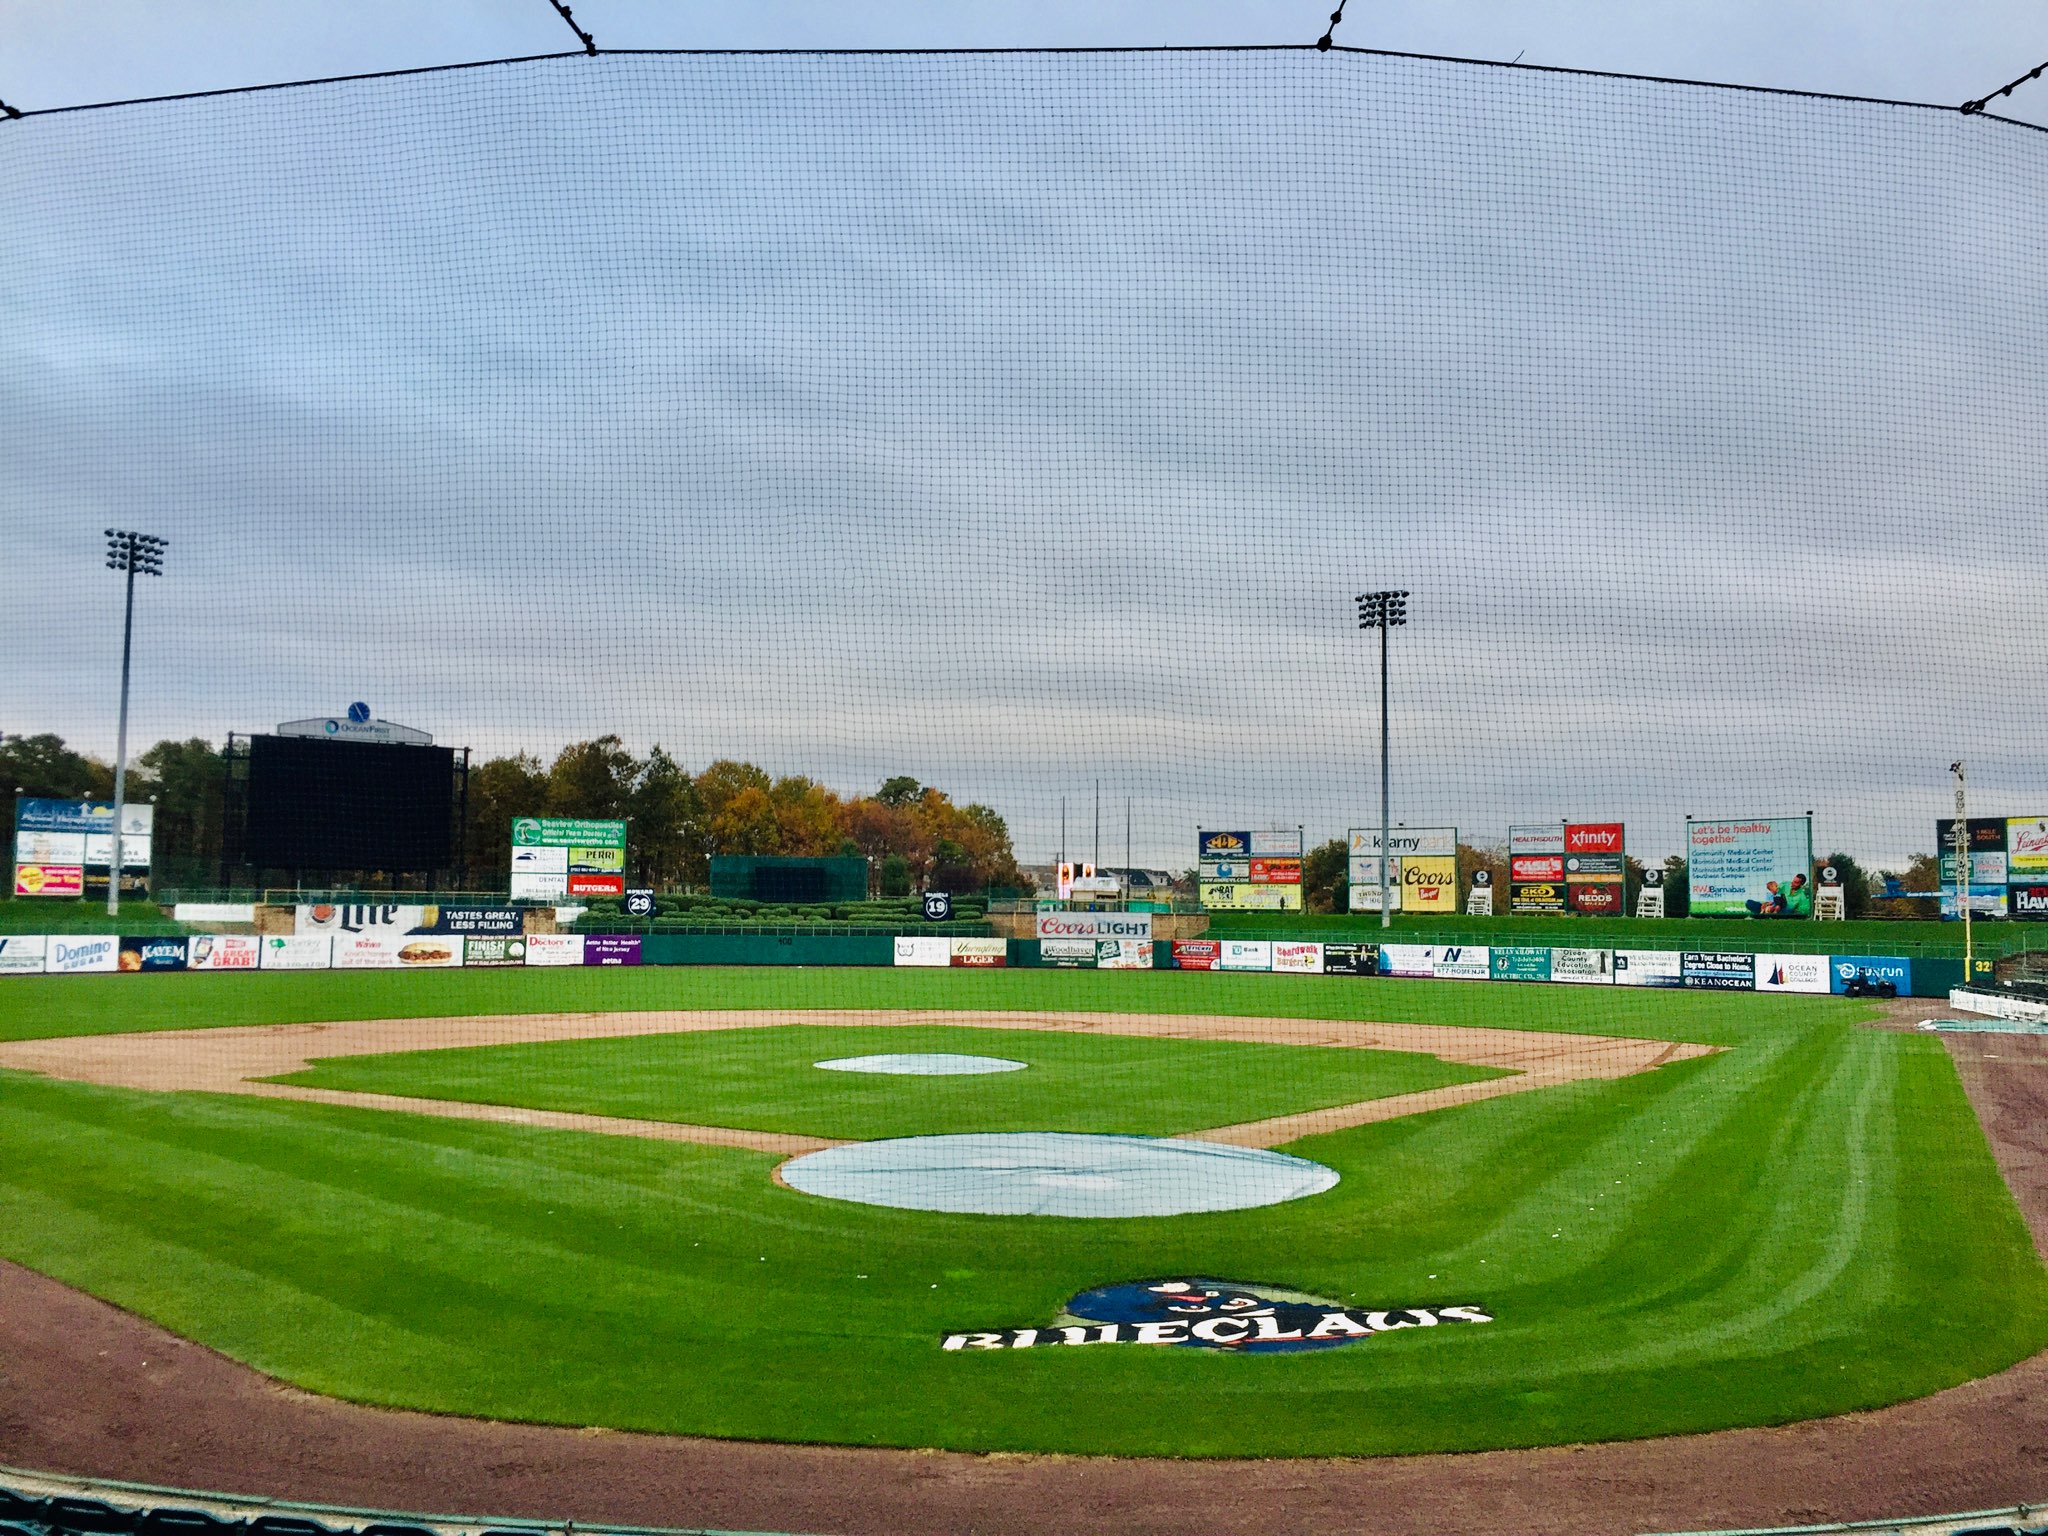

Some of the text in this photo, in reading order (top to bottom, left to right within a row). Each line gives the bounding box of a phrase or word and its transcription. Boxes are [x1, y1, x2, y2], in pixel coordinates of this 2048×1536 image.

[1691, 823, 1771, 835] Let's be healthy
[1373, 836, 1420, 851] karny
[1571, 831, 1617, 847] xfinity
[1404, 866, 1454, 885] Coors
[631, 898, 650, 910] 29
[929, 901, 946, 912] 19
[446, 911, 519, 921] TASTES GREAT,
[451, 921, 514, 930] LESS FILLING
[1040, 917, 1149, 936] Coors LIGHT
[467, 940, 506, 951] FINISH
[529, 936, 564, 946] Doctors
[55, 941, 111, 963] Domino
[142, 945, 185, 961] KAYEM
[213, 957, 256, 967] GRAB!
[963, 955, 995, 964] LAGER
[1700, 953, 1715, 962] Your
[1716, 954, 1752, 963] Bachelor's
[1724, 962, 1731, 970] to
[941, 1305, 1495, 1351] BLUECLAWS
